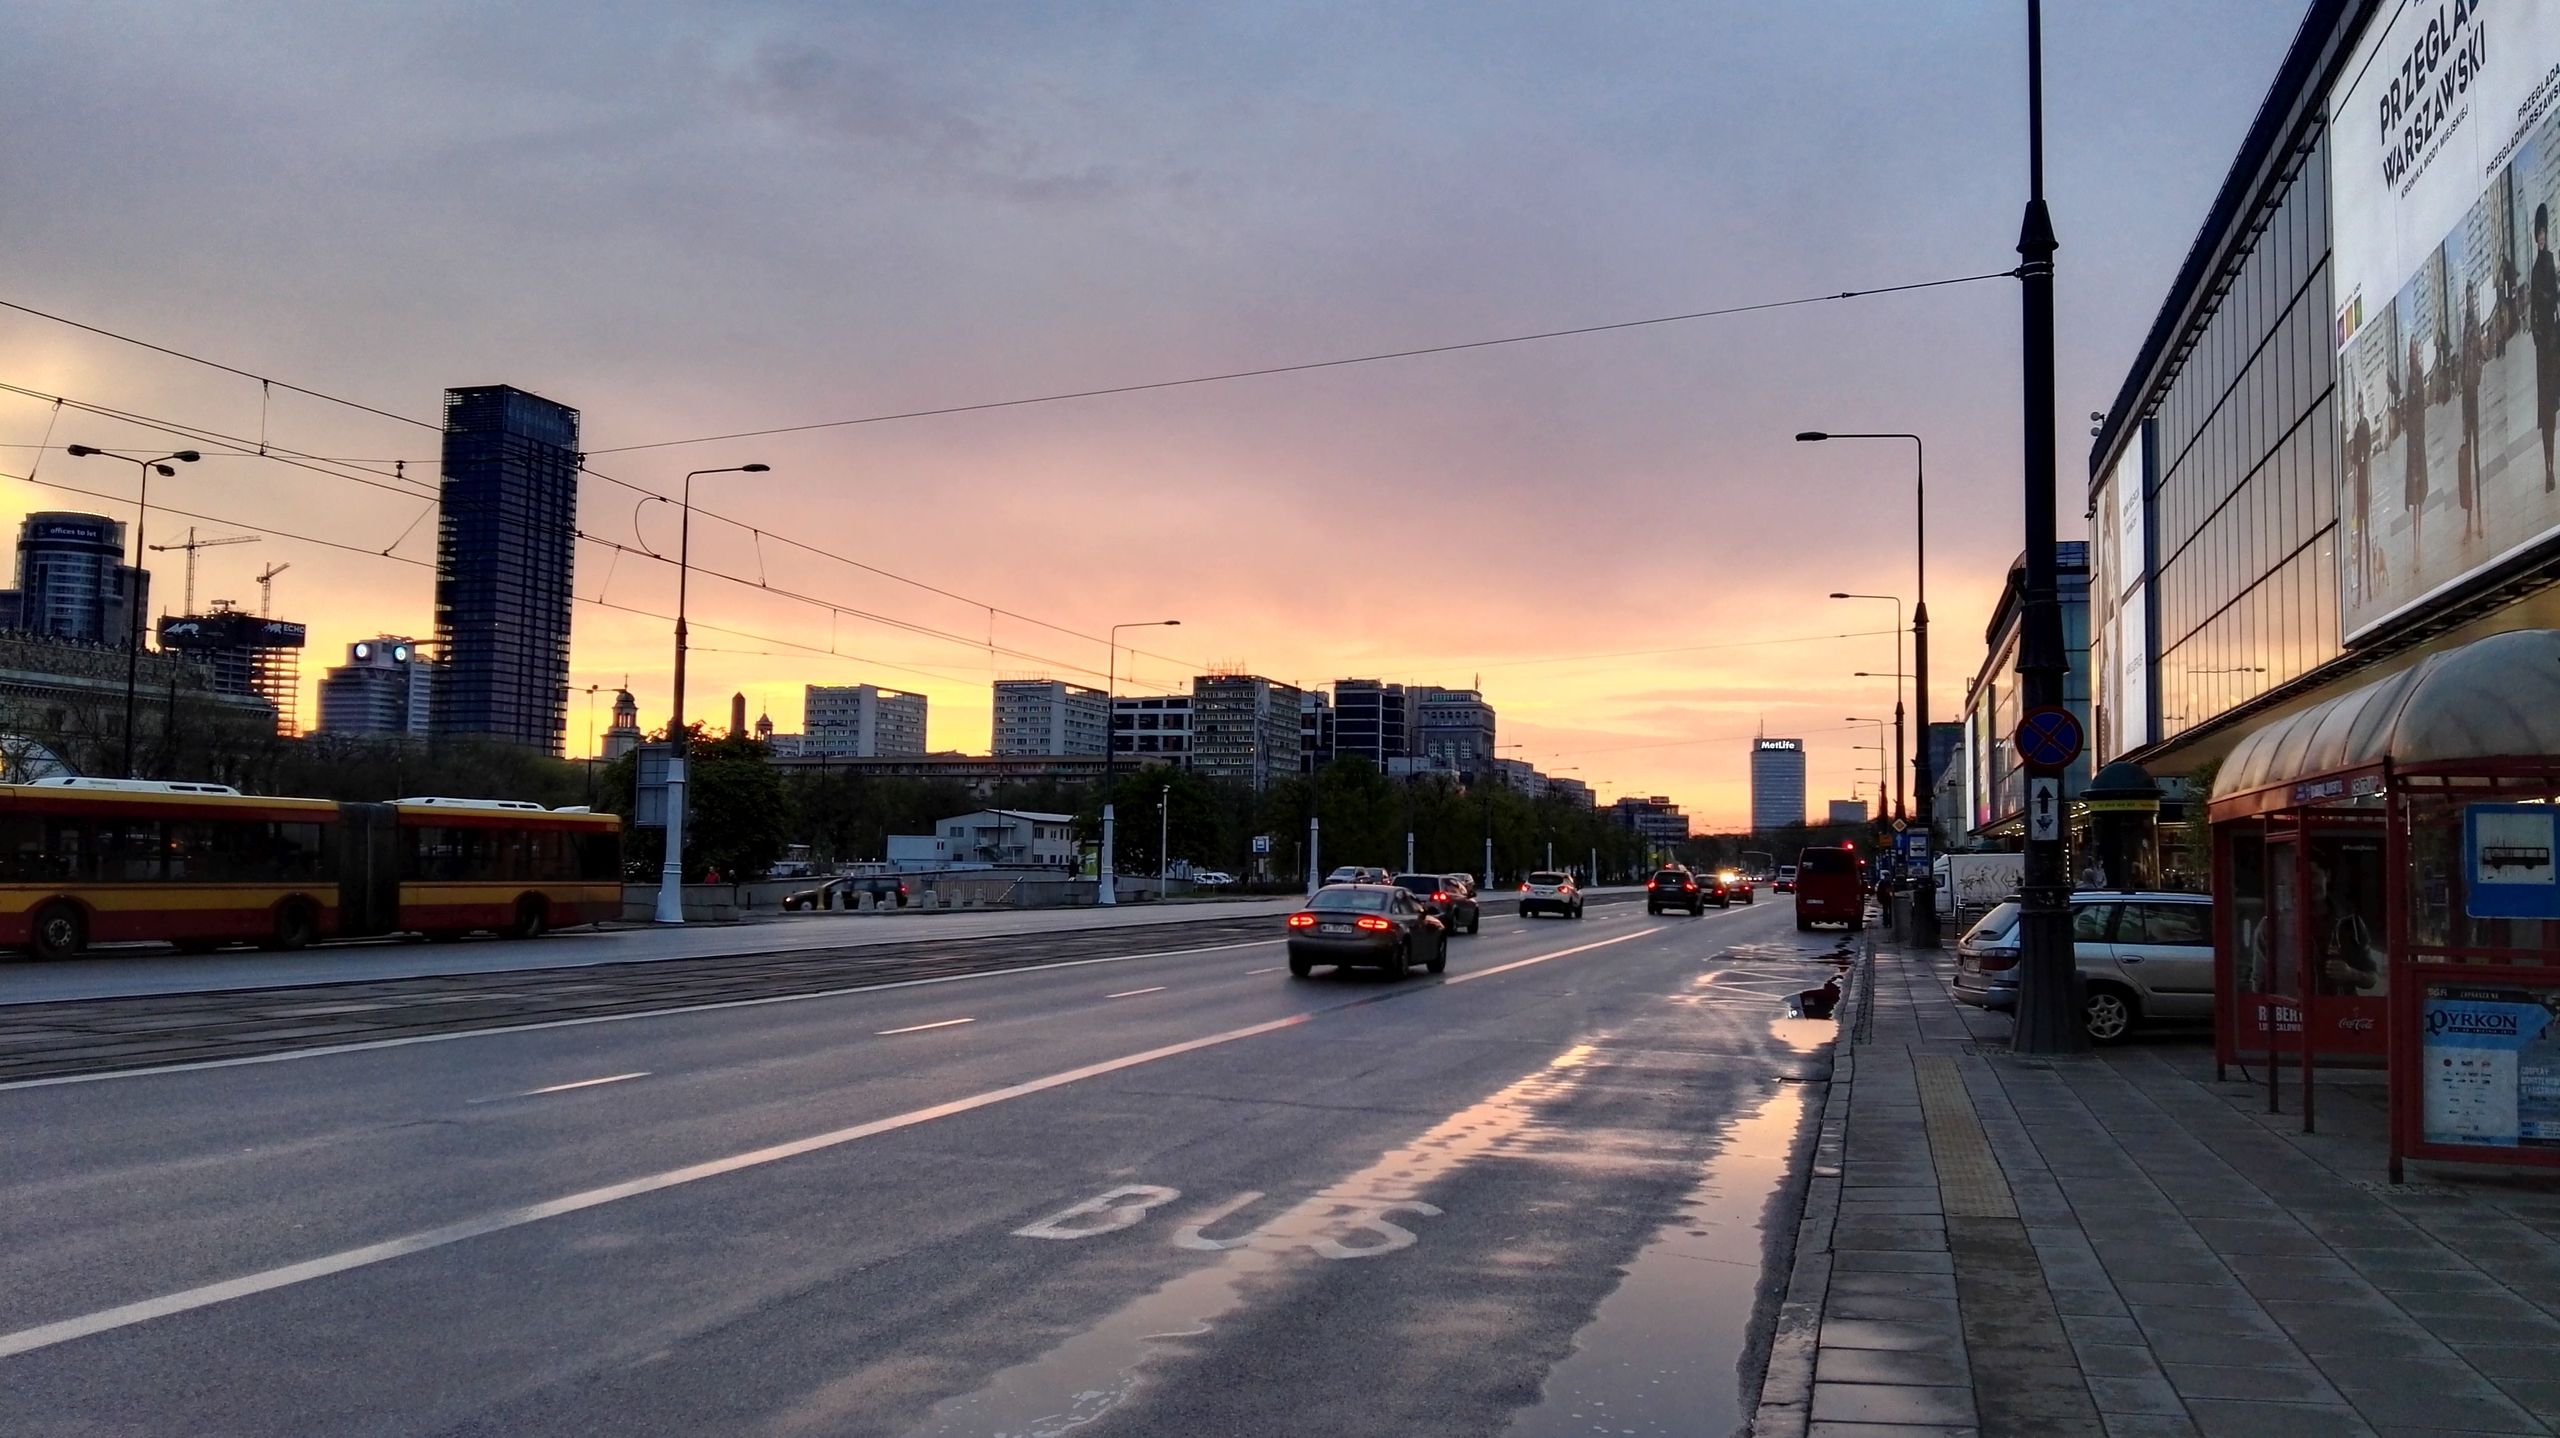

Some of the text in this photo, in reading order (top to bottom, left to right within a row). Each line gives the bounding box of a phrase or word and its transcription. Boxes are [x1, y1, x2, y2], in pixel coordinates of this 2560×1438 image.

[2379, 0, 2479, 146] PRZEGLĄ
[2382, 20, 2486, 192] WARSZAWSKI
[2401, 103, 2469, 200] KRONIKA MODY MIEJSKIEJ
[50, 526, 76, 535] offices
[87, 530, 97, 538] let
[283, 624, 305, 633] ECHO
[1761, 740, 1795, 749] MetLife
[2425, 1009, 2518, 1037] PYRKON
[1008, 1183, 1446, 1260] BUS
